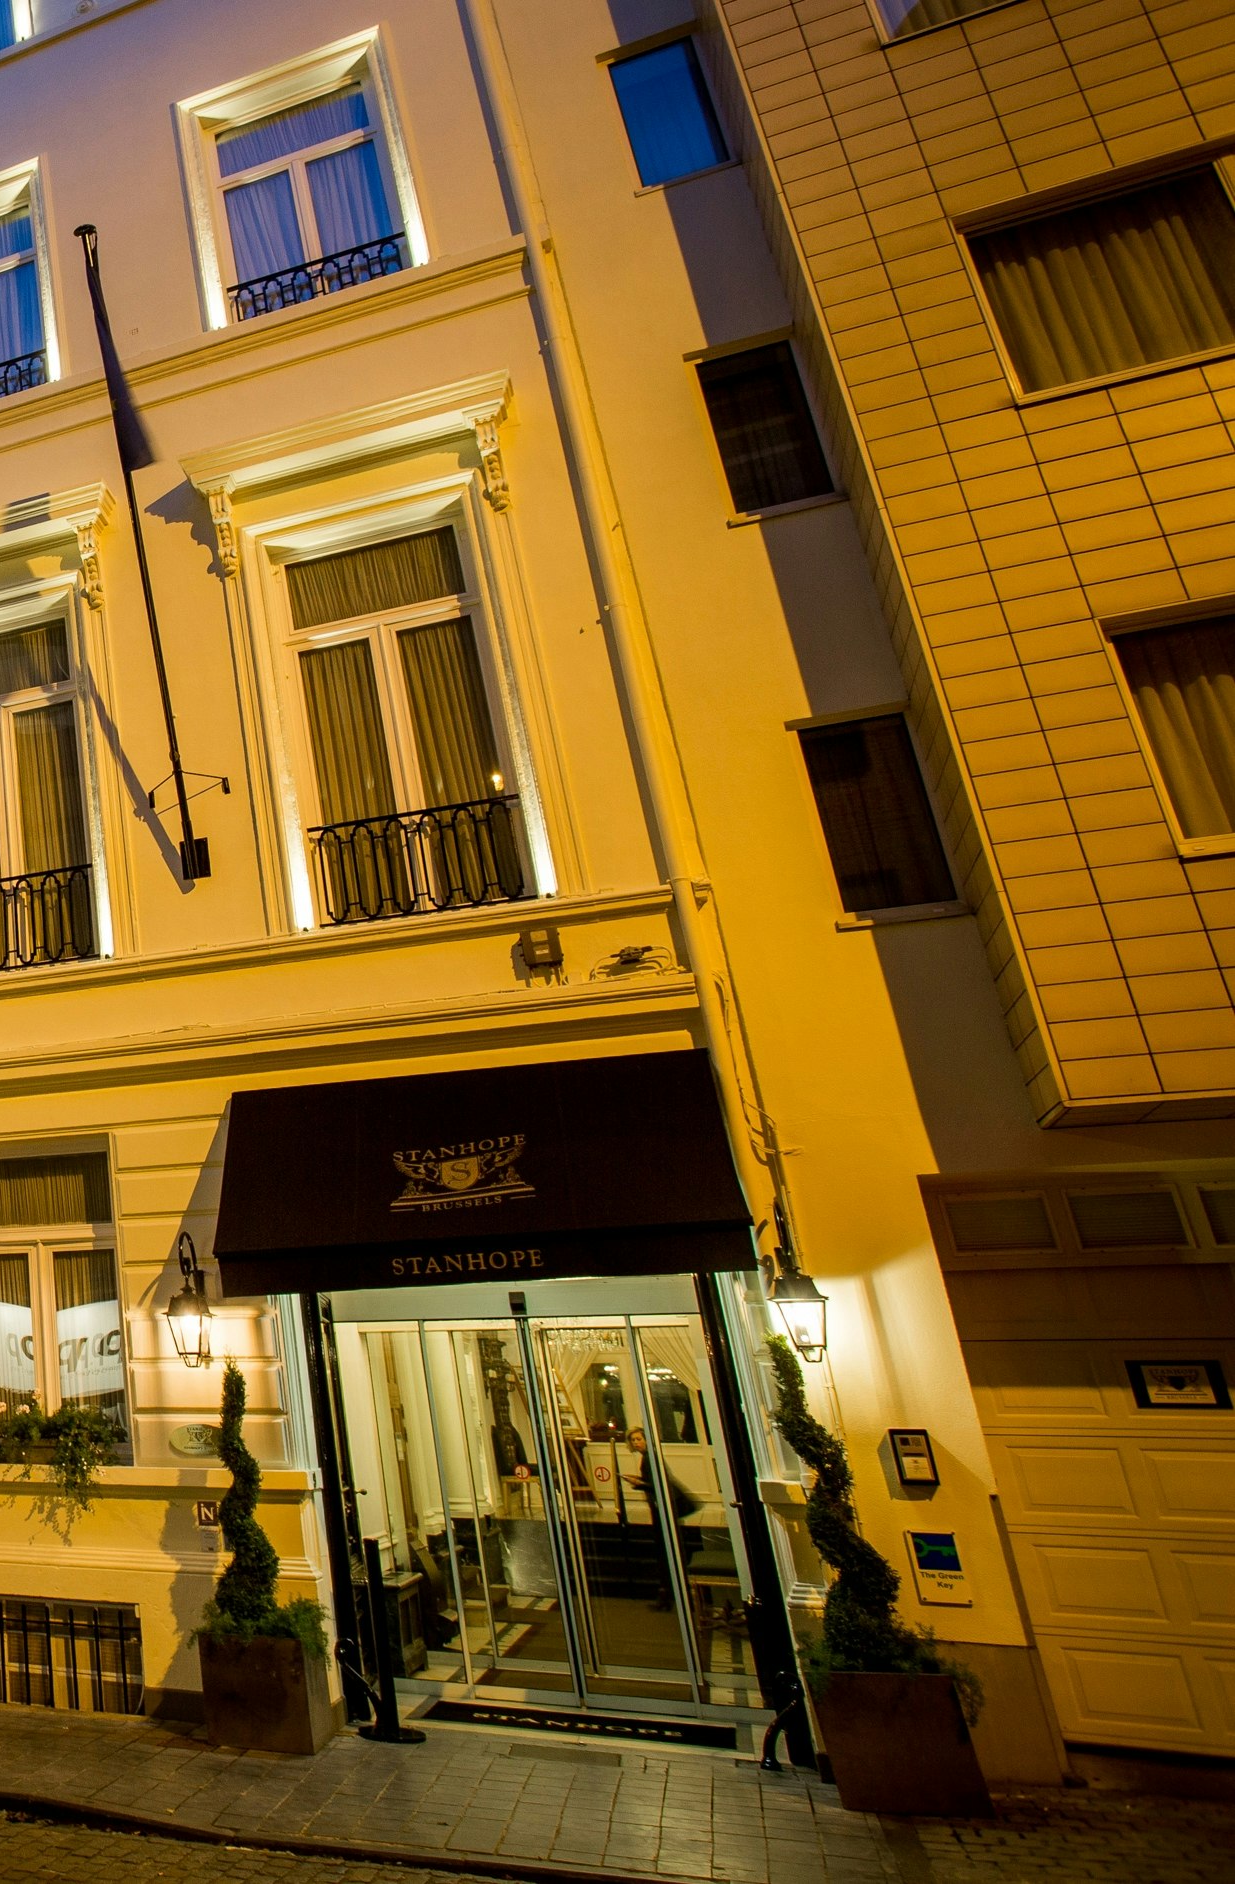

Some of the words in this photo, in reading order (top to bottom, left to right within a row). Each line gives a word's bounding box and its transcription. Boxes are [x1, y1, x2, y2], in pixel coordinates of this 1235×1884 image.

[393, 1134, 526, 1162] STANHOPE
[421, 1196, 503, 1213] BRUSSELS
[391, 1248, 545, 1276] STANHOPE
[1147, 1367, 1196, 1376] STANHOPE
[938, 1572, 964, 1580] Green
[937, 1581, 954, 1590] Key
[472, 1712, 683, 1737] STANHOPE
